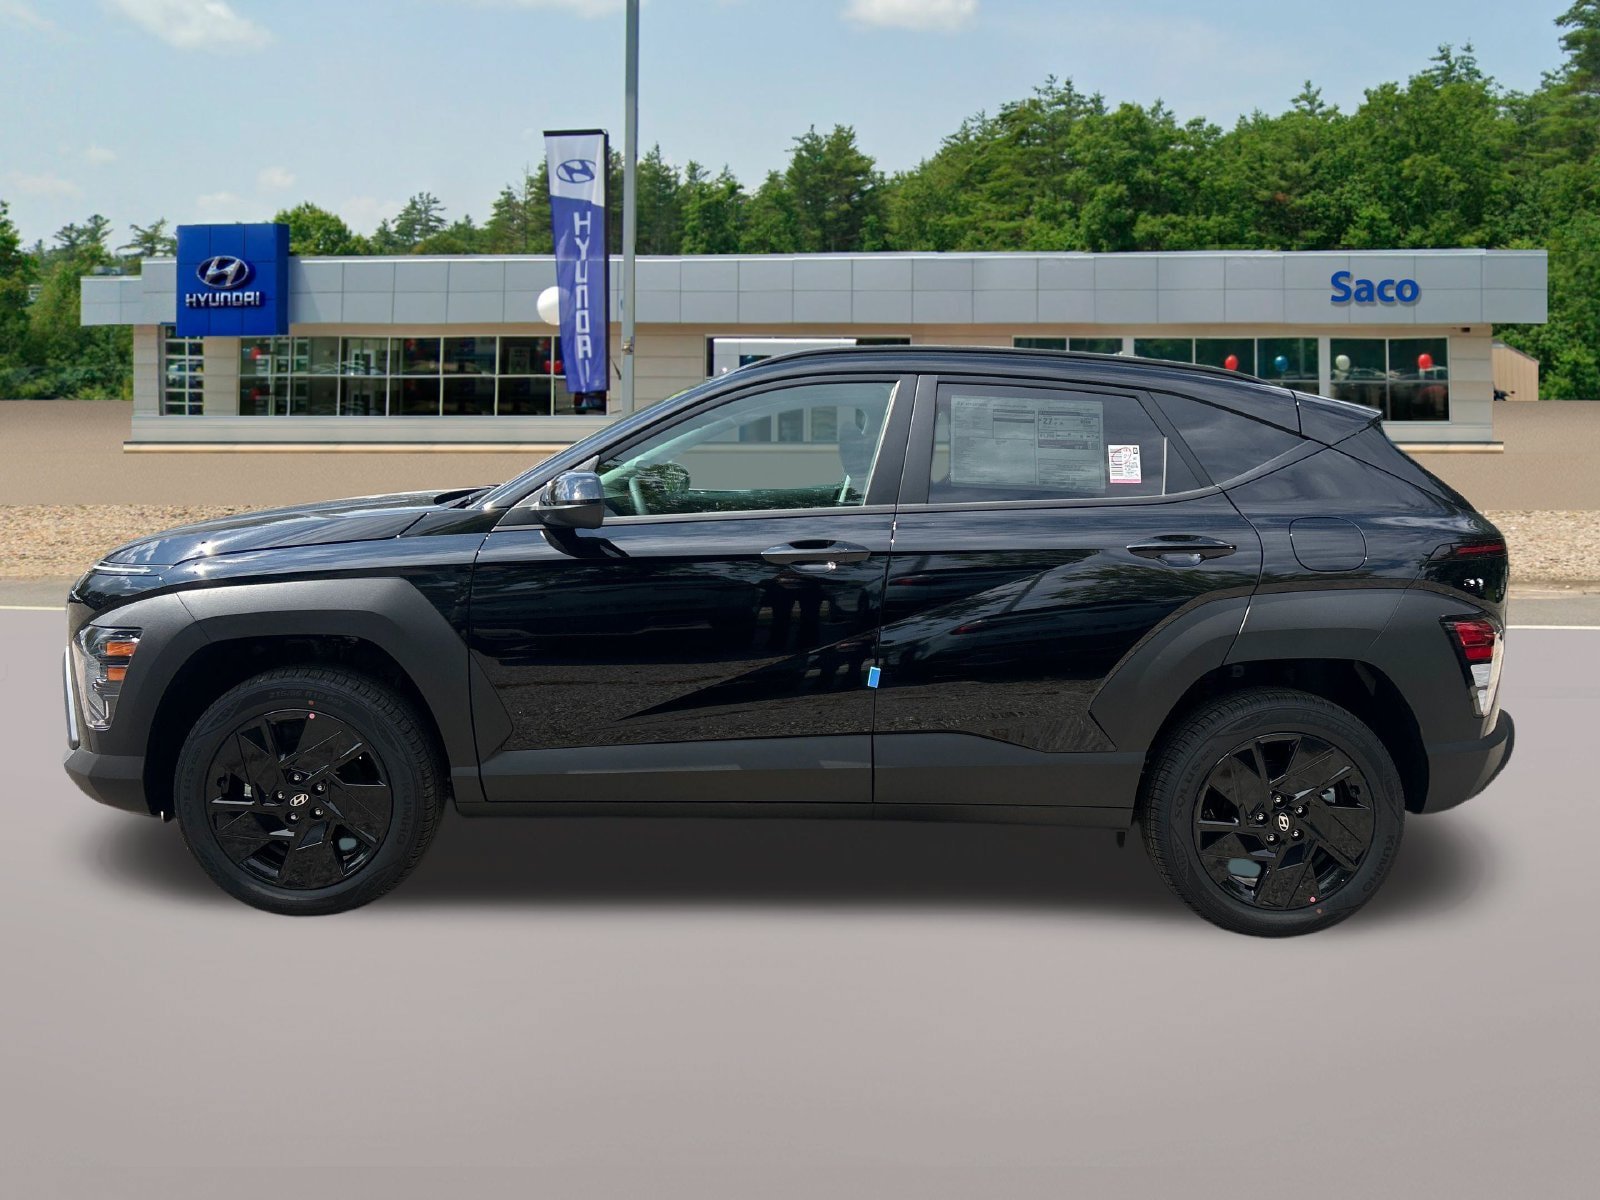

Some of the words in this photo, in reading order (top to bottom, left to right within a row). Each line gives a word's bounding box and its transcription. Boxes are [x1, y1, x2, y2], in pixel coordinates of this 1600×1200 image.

[185, 291, 260, 307] HYUNDAI
[573, 211, 592, 383] HYUNDAI
[1330, 270, 1420, 302] Saco
